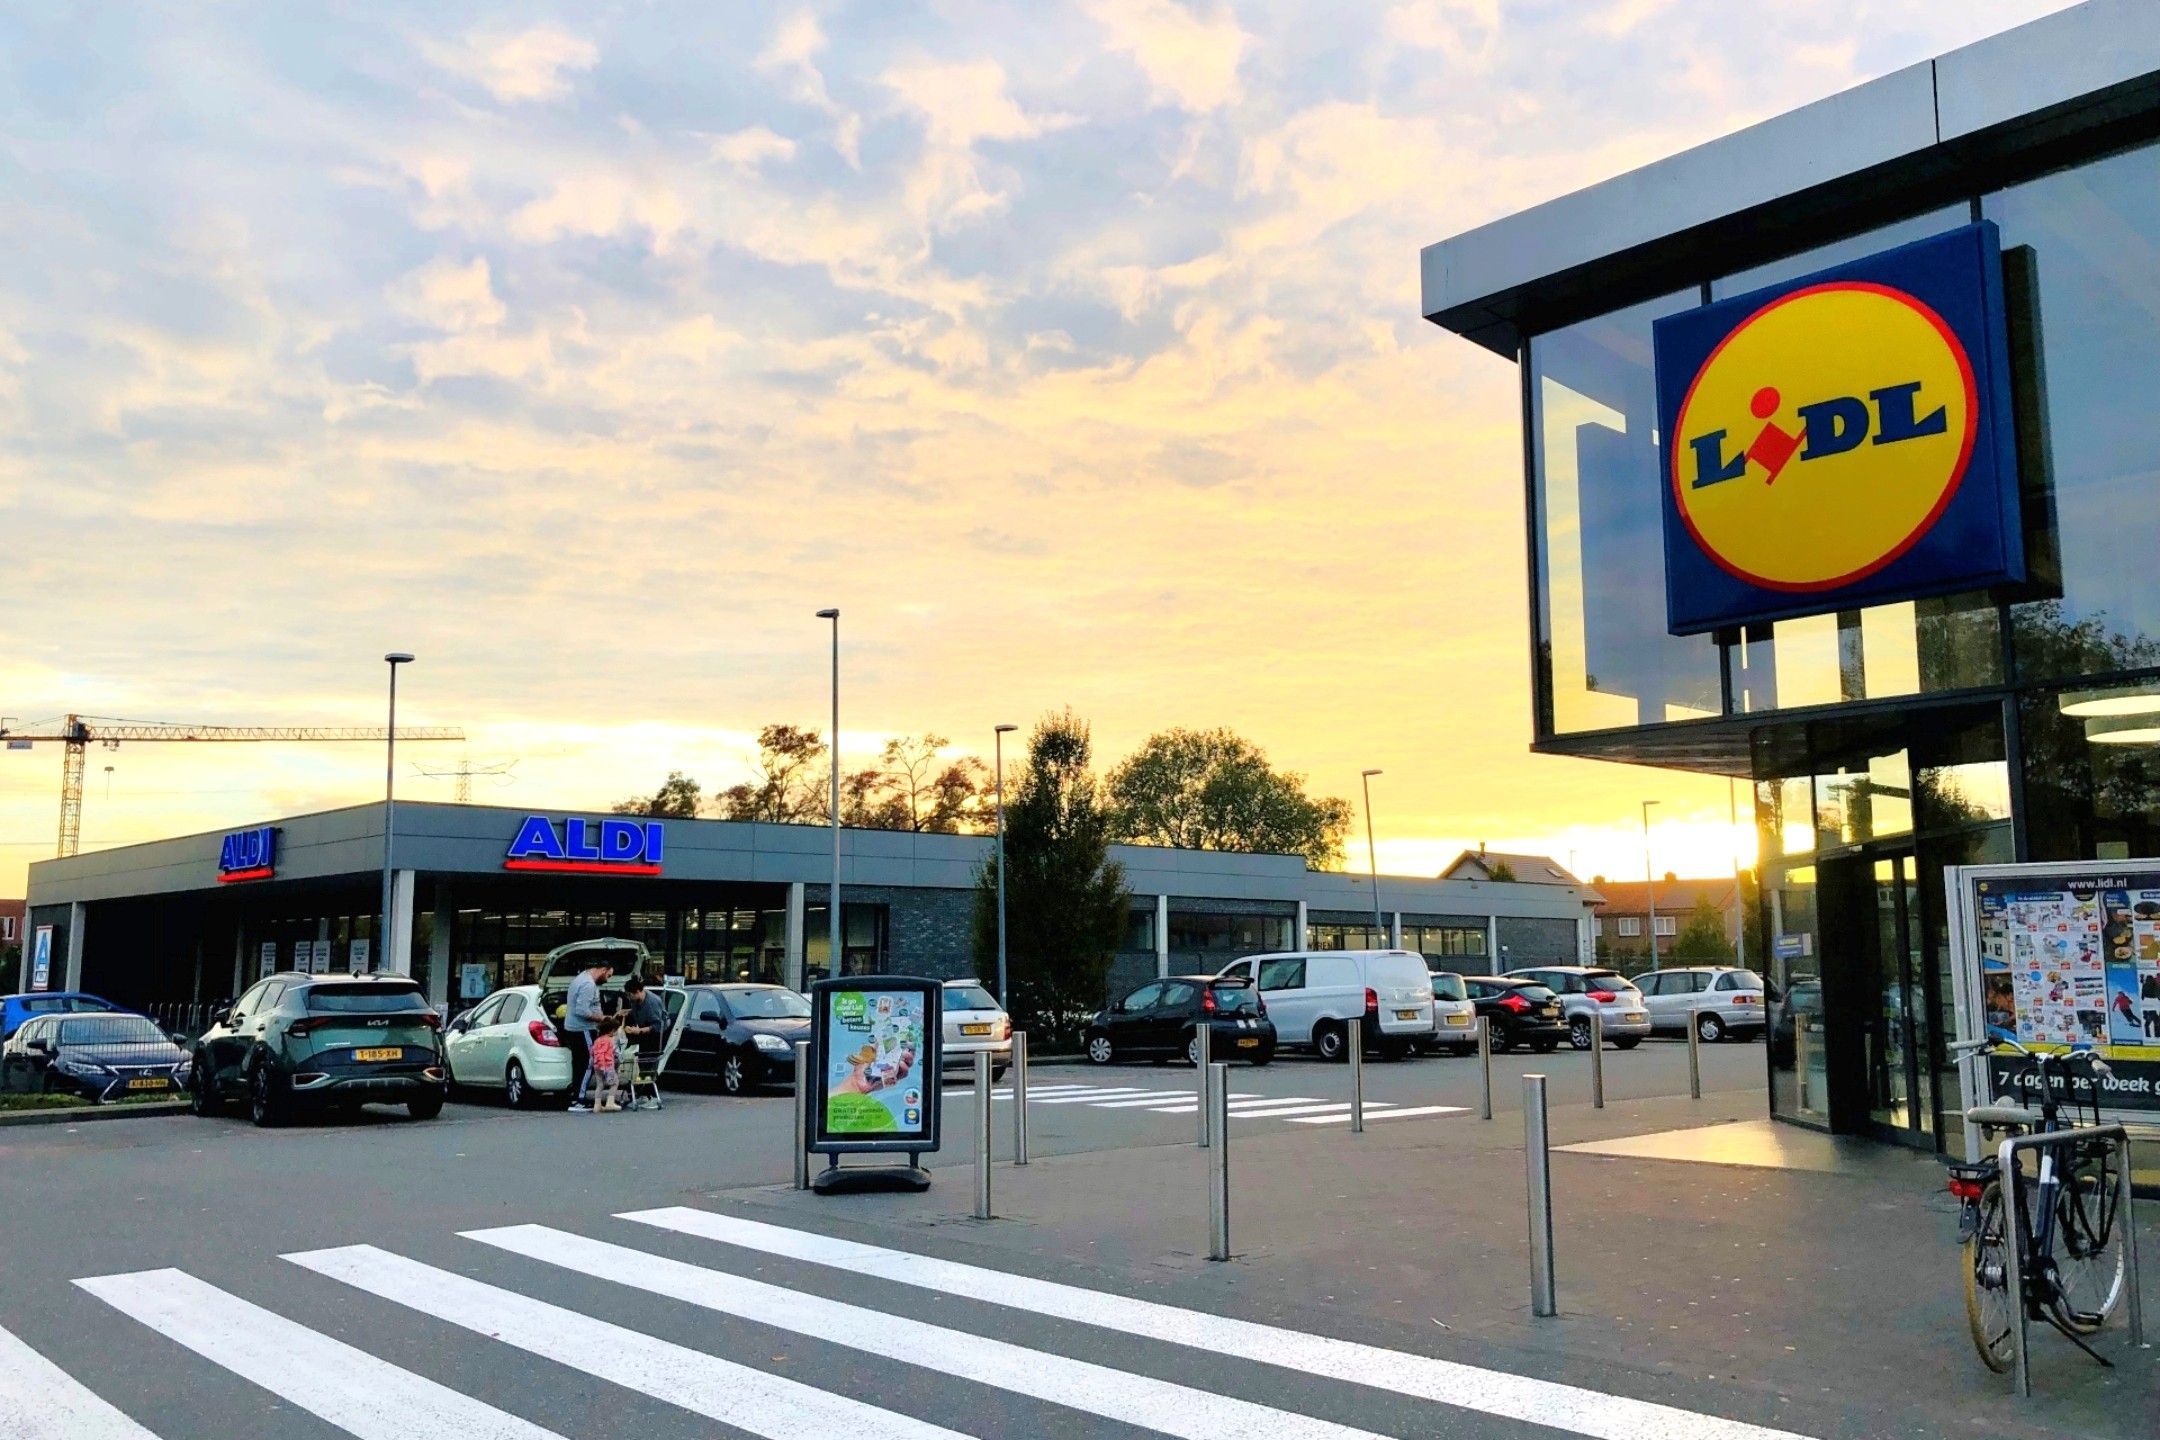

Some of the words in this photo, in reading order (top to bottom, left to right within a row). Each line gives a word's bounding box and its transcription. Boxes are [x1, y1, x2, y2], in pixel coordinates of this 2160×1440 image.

[219, 827, 274, 871] ALDI
[507, 815, 665, 863] ALDI
[2067, 878, 2127, 889] www.lidl.nl
[1998, 1071, 2010, 1086] 7
[2102, 1077, 2150, 1093] week
